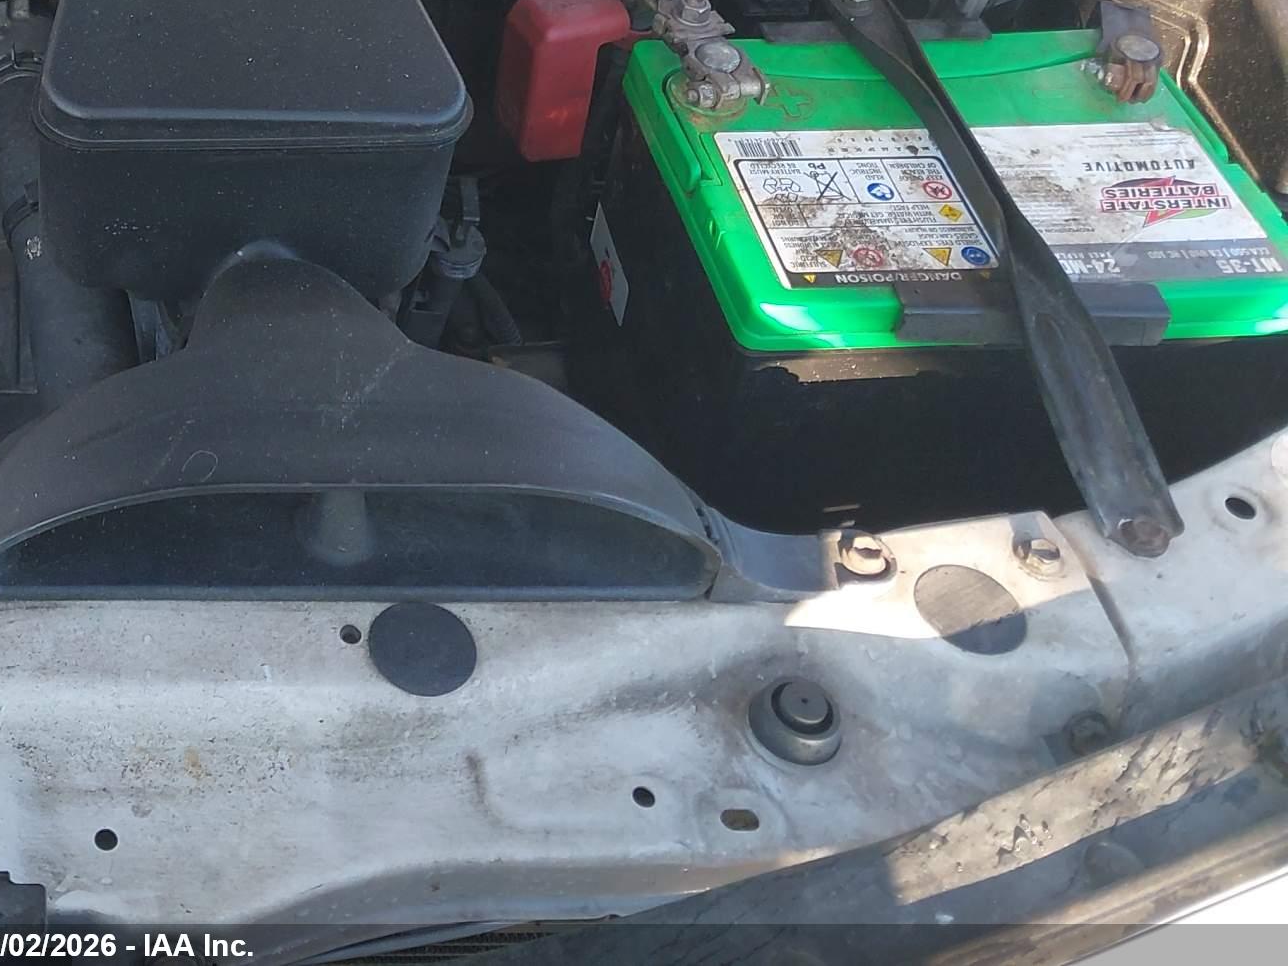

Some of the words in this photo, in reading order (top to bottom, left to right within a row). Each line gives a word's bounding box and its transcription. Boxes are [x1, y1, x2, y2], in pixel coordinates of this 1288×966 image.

[1082, 159, 1195, 172] AUTOMOTIVE
[1103, 186, 1215, 199] BATTERIES
[1104, 198, 1228, 212] INTERSTATE
[1215, 257, 1284, 274] MT-35
[834, 272, 962, 283] DANGER/POISON
